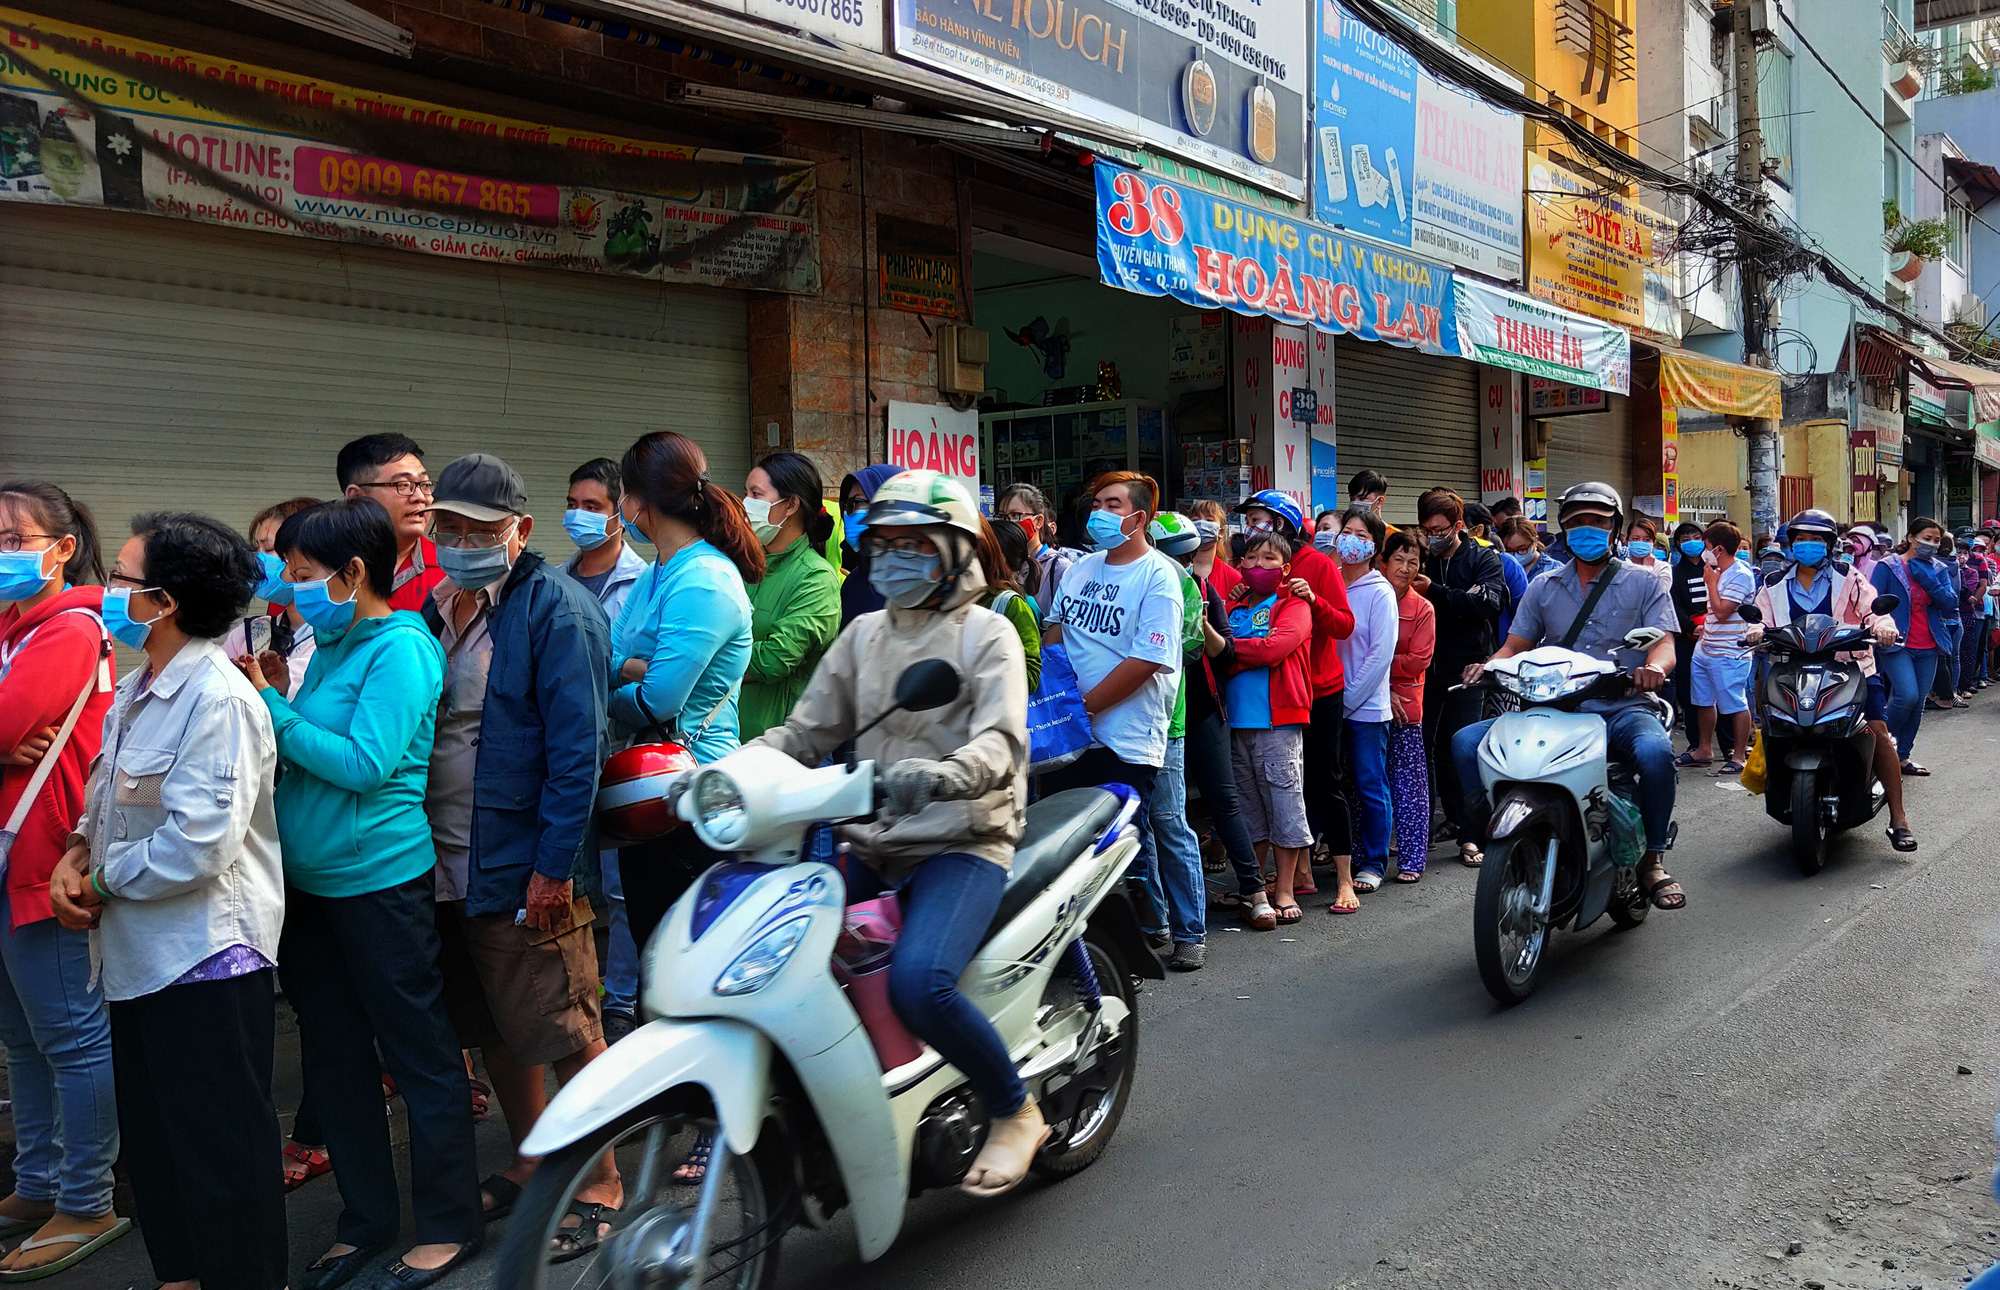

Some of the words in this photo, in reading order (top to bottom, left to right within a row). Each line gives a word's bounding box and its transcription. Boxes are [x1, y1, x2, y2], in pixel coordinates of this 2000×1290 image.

[915, 4, 937, 27] BẢO
[940, 17, 969, 39] HÀNH
[971, 28, 996, 50] VĨNH
[998, 38, 1020, 60] VIỄN
[915, 33, 934, 50] Điện
[1221, 32, 1241, 57] 090
[1242, 44, 1261, 68] 858
[1263, 57, 1286, 81] 0116
[153, 128, 290, 182] HOTLINE:
[1419, 100, 1488, 184] THANH
[319, 155, 403, 196] 0909
[413, 169, 469, 206] 667
[479, 180, 531, 218] 865
[295, 199, 558, 245] www.nuocepbuoi.vn
[756, 217, 788, 231] BARIELLE
[1108, 172, 1185, 247] 38
[197, 198, 249, 224] PHẨM
[254, 211, 289, 229] CHO
[431, 235, 467, 255] GIẢM
[471, 241, 499, 259] CÂN
[1213, 202, 1300, 251] DỤNG
[1307, 233, 1343, 269] CỤ
[1350, 244, 1366, 270] Y
[1373, 252, 1432, 289] KHOA
[886, 252, 953, 286] PHARVITACO
[1112, 239, 1142, 267] GUYỄN
[1143, 245, 1162, 270] GIẢN
[1156, 273, 1188, 292] Q.10
[1192, 244, 1363, 333] HOÀNG
[1373, 292, 1443, 349] LAN
[1274, 336, 1305, 376] DỤNG
[1316, 330, 1327, 358] CỤ
[1493, 314, 1555, 363] THANH
[1561, 325, 1583, 370] ÂN
[1245, 357, 1260, 398] CỤ
[1319, 367, 1325, 388] Y
[1717, 385, 1734, 403] HÀ
[1279, 390, 1296, 429] C
[1295, 392, 1315, 410] 38
[1317, 404, 1334, 426] HOA
[1489, 384, 1503, 415] CỤ
[1250, 413, 1258, 444] Y
[1493, 426, 1500, 450] Y
[892, 417, 976, 478] HOÀNG
[1285, 444, 1295, 472] Y
[1482, 468, 1511, 493] KHOA
[1951, 487, 1967, 497] 30
[1854, 480, 1876, 523] KHÁNH
[1102, 583, 1120, 602] SO
[1059, 595, 1125, 637] SERIOUS
